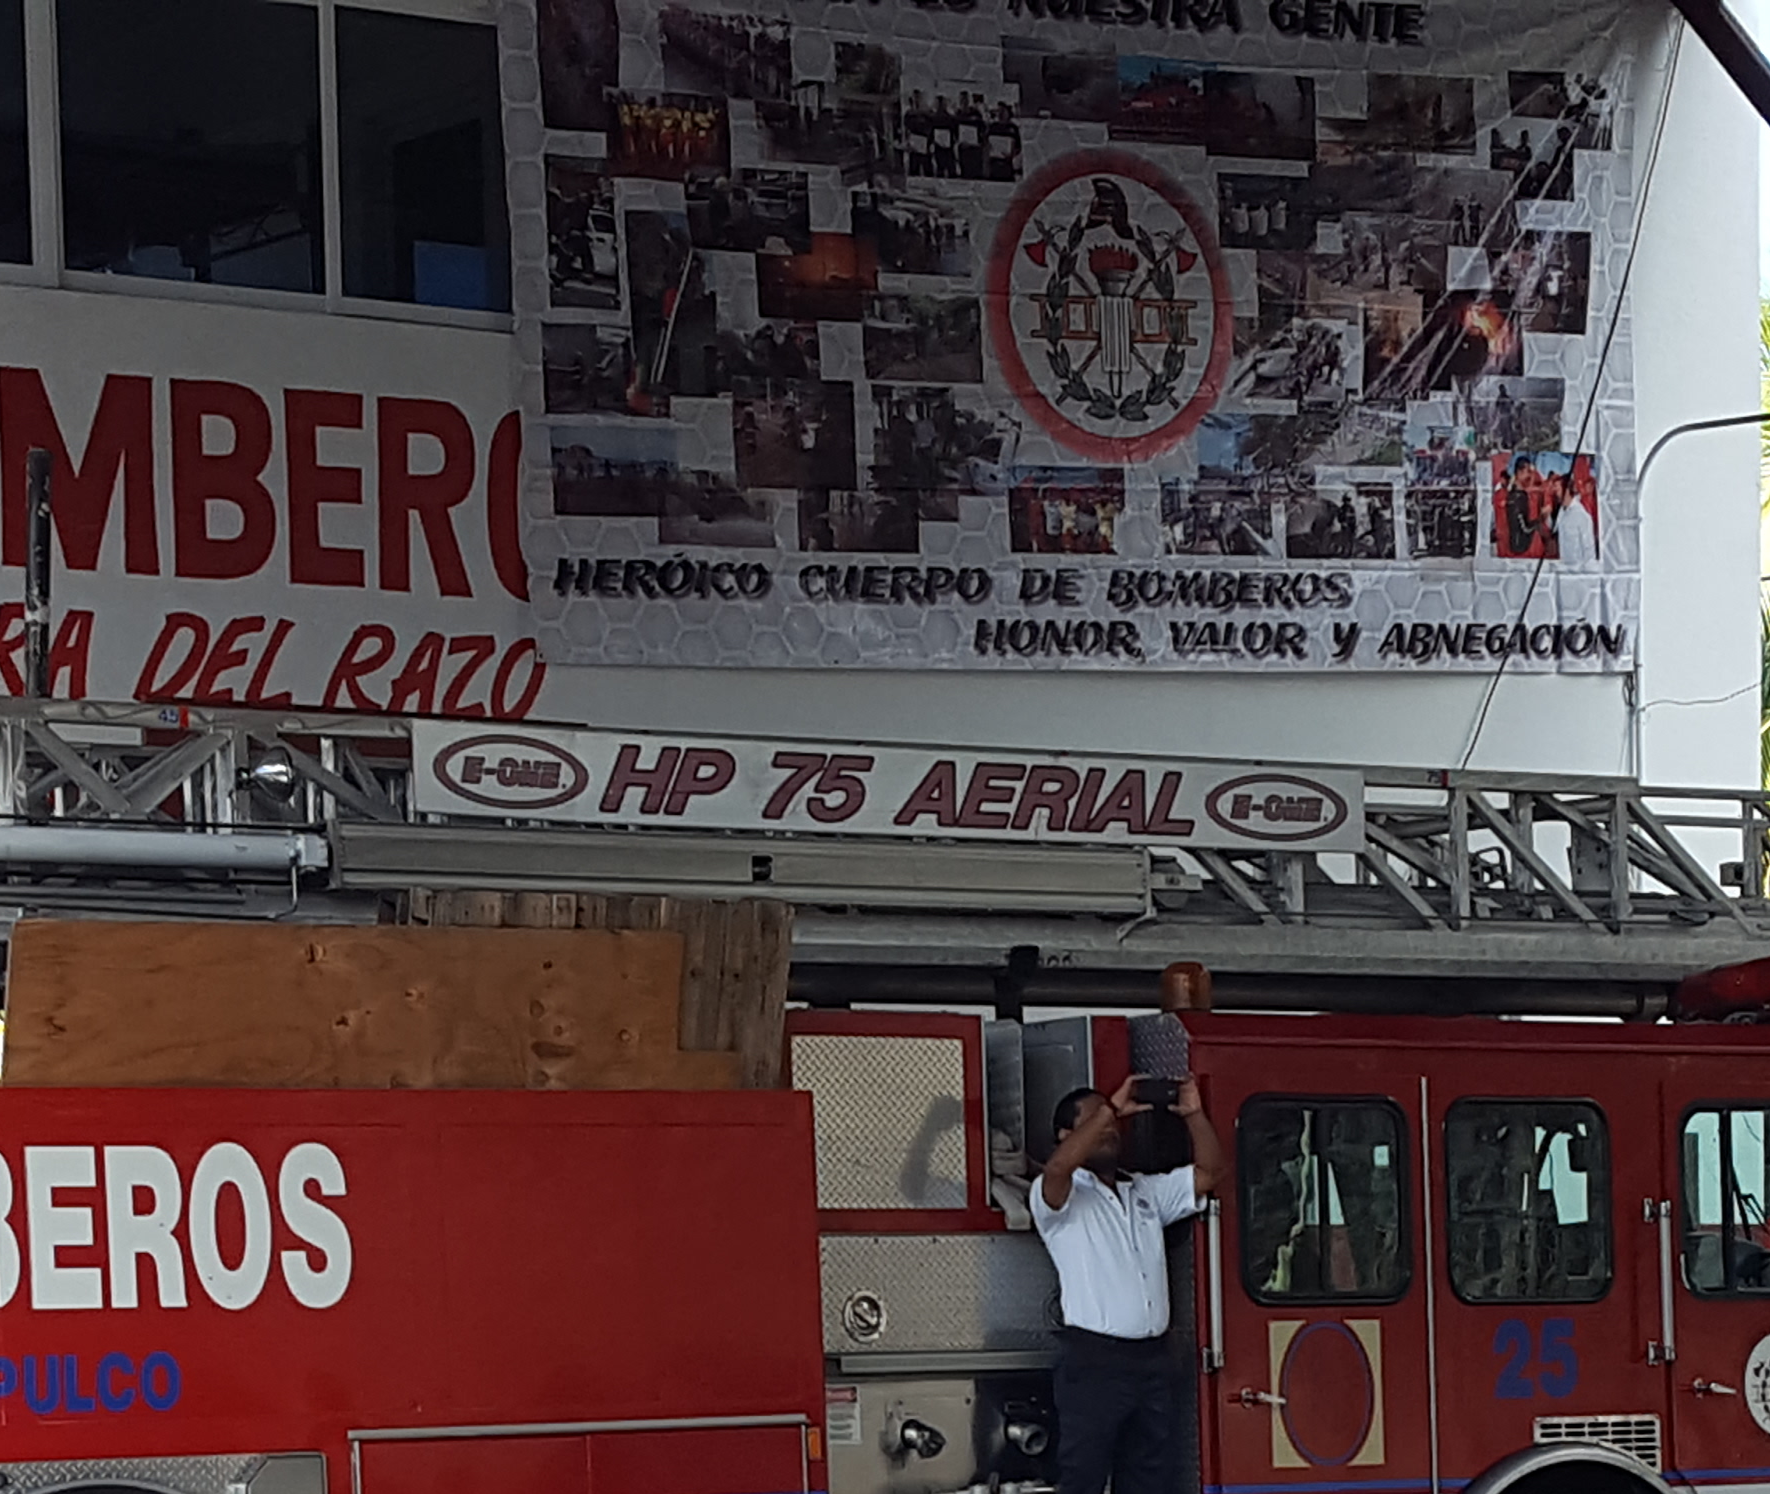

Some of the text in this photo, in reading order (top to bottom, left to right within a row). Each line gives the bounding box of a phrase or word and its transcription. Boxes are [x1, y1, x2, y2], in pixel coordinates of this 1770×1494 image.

[1269, 0, 1427, 47] GENTE
[797, 563, 994, 605] CUERPO
[1018, 566, 1087, 605] DE
[1105, 567, 1355, 610] BOMBEROS
[132, 611, 297, 708] DEL
[322, 623, 548, 720] RAZO
[1168, 619, 1309, 660] VALOR
[1378, 614, 1628, 659] ABNEGACIÓN
[599, 743, 1195, 838] HP 75 AERIAL
[1492, 1318, 1579, 1400] 25
